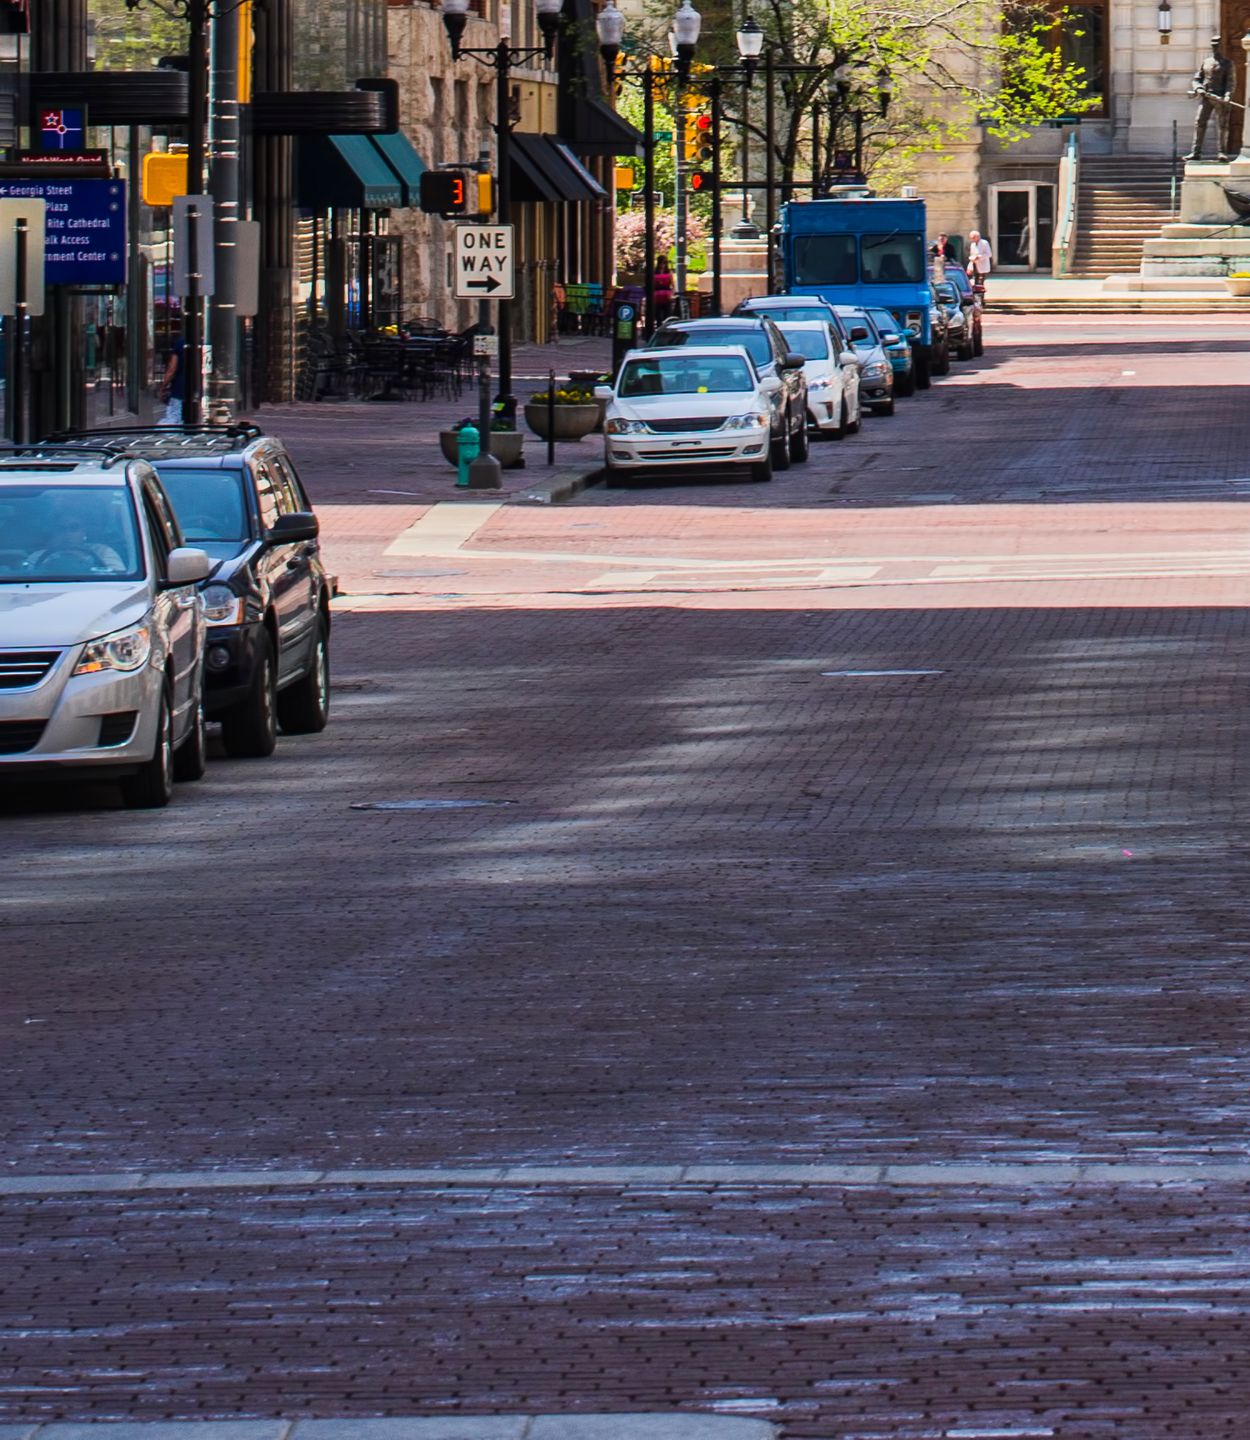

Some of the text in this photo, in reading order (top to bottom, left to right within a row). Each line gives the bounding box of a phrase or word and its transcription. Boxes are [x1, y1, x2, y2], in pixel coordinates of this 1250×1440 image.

[9, 185, 73, 198] Georgia Street
[452, 179, 464, 204] 3
[47, 217, 111, 228] Rite Cathedral
[61, 235, 90, 245] Access
[463, 232, 506, 249] ONE
[77, 251, 107, 261] Center
[462, 255, 508, 272] WAY
